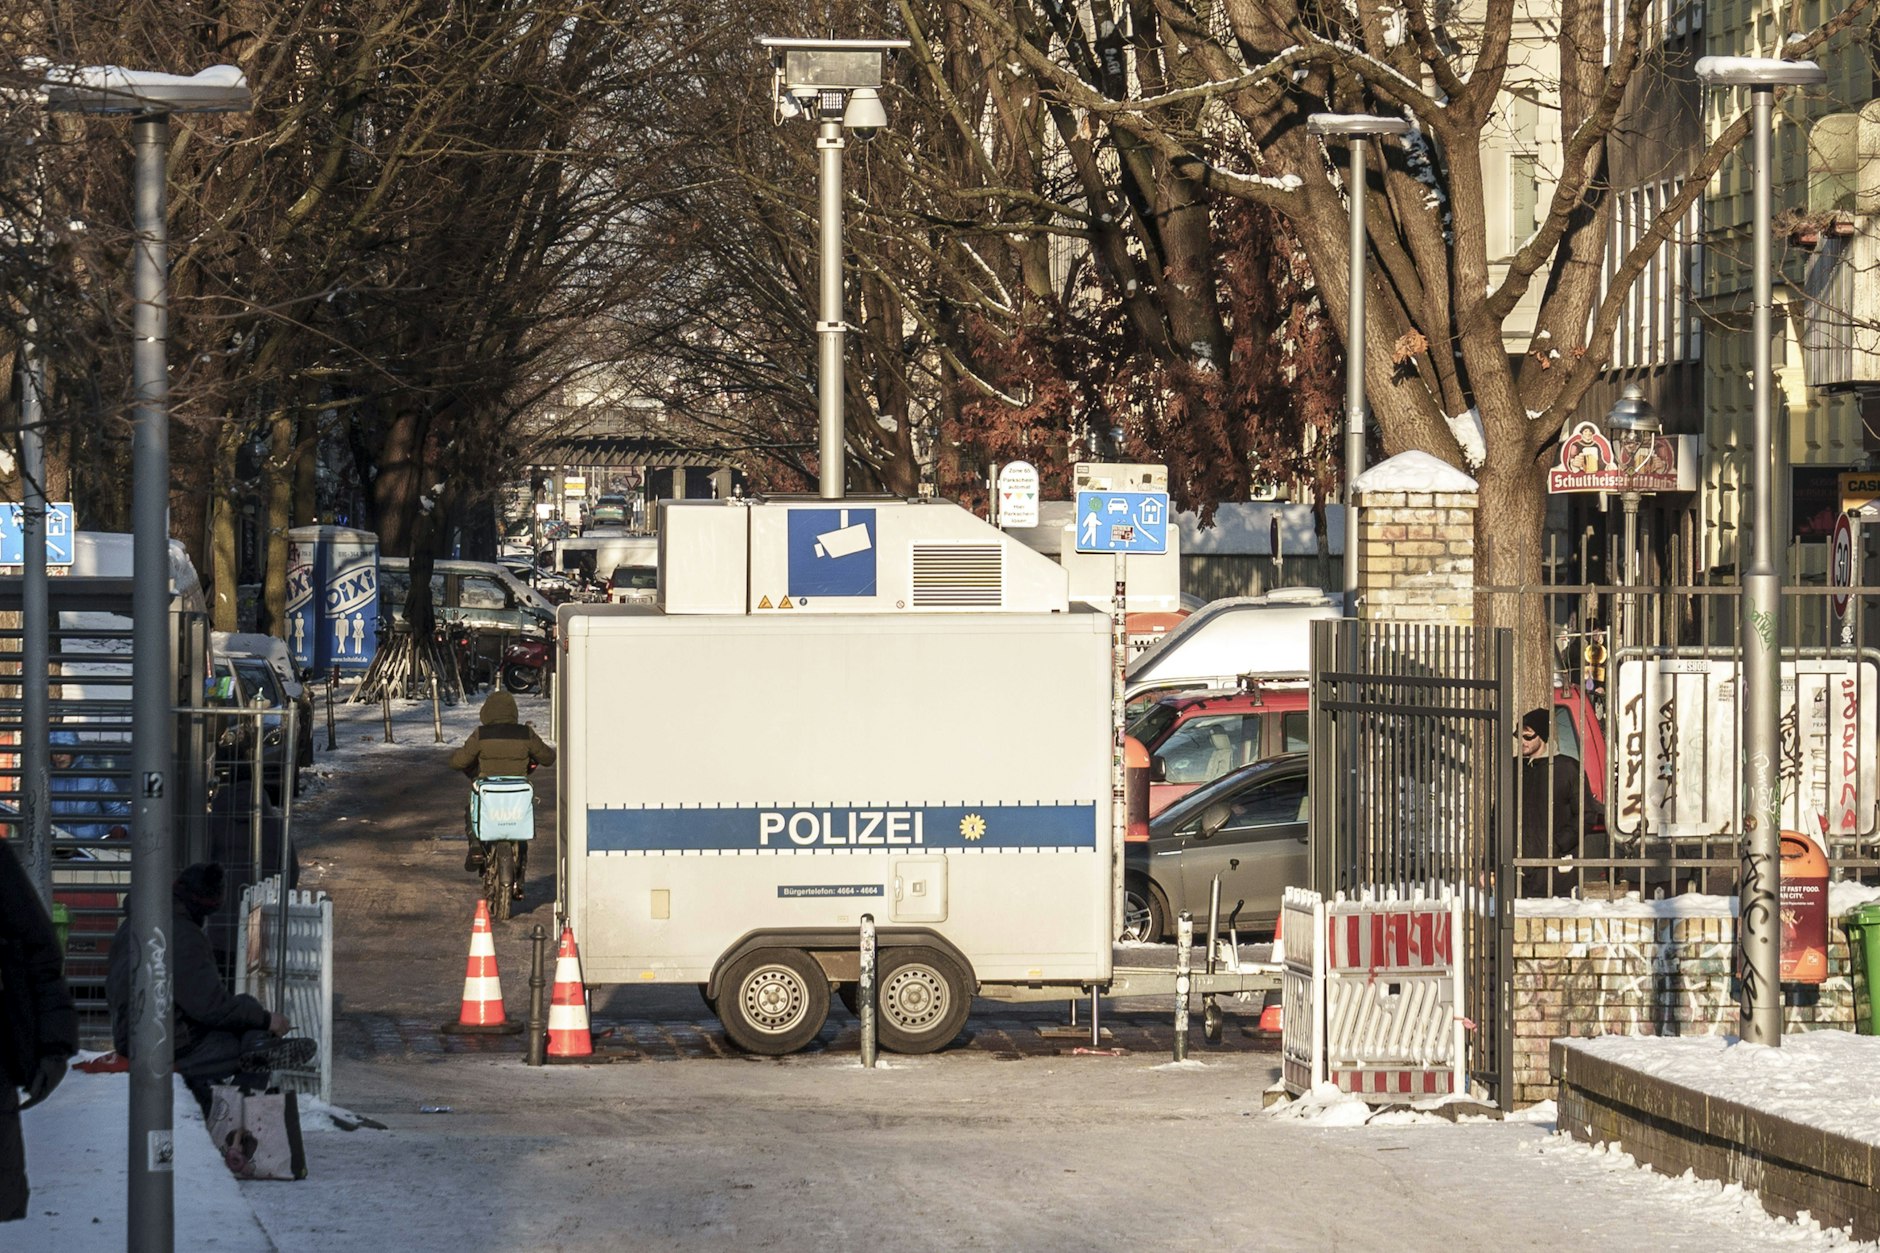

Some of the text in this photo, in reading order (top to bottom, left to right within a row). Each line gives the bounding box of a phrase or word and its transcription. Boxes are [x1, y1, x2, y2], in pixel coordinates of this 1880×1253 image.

[1847, 479, 1880, 492] CAS
[1836, 542, 1848, 587] 30
[759, 811, 924, 846] POLIZEI
[783, 887, 836, 897] Bürgertelefon:
[837, 887, 855, 895] 4664
[860, 886, 878, 895] 4664
[1802, 885, 1821, 893] FOOD.
